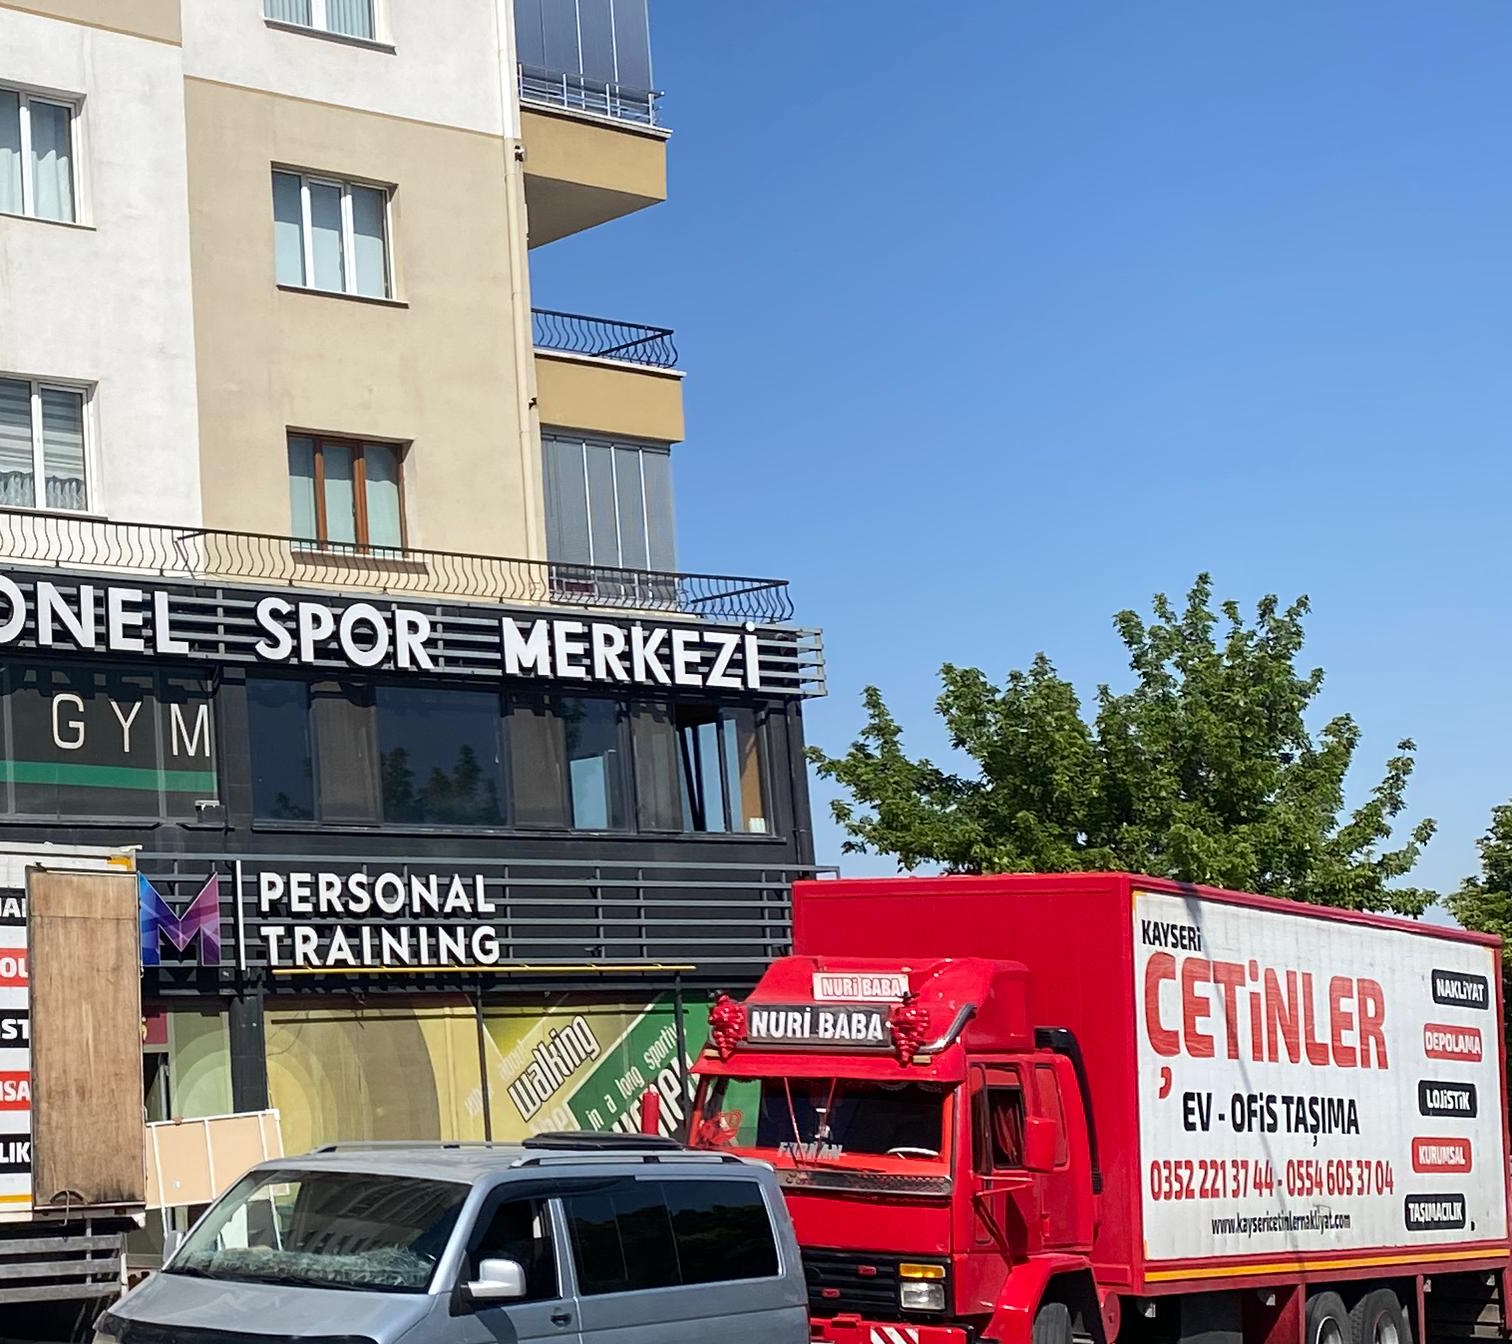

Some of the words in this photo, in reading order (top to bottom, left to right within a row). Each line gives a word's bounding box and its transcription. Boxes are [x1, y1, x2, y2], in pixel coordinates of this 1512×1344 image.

[254, 595, 434, 671] SPOR
[50, 691, 212, 758] GYM
[258, 870, 497, 916] PERSONAL
[258, 923, 501, 967] TRAINING
[862, 977, 903, 998] BABA
[818, 1011, 884, 1041] BABA
[1425, 1031, 1482, 1055] DEPOLAMA
[506, 1014, 601, 1124] walking
[603, 1093, 618, 1114] a
[614, 1065, 646, 1100] long
[1182, 1091, 1213, 1133] EV
[1281, 1095, 1361, 1147] TAŞIMA
[1418, 1145, 1466, 1166] KURUMSAL
[1150, 1159, 1195, 1201] 0352
[1199, 1159, 1227, 1199] 221
[1231, 1159, 1249, 1198] 37
[1253, 1159, 1273, 1197] 44
[1287, 1159, 1324, 1197] 0554
[1326, 1159, 1353, 1196] 605
[1357, 1160, 1372, 1196] 37
[1375, 1160, 1394, 1195] 04
